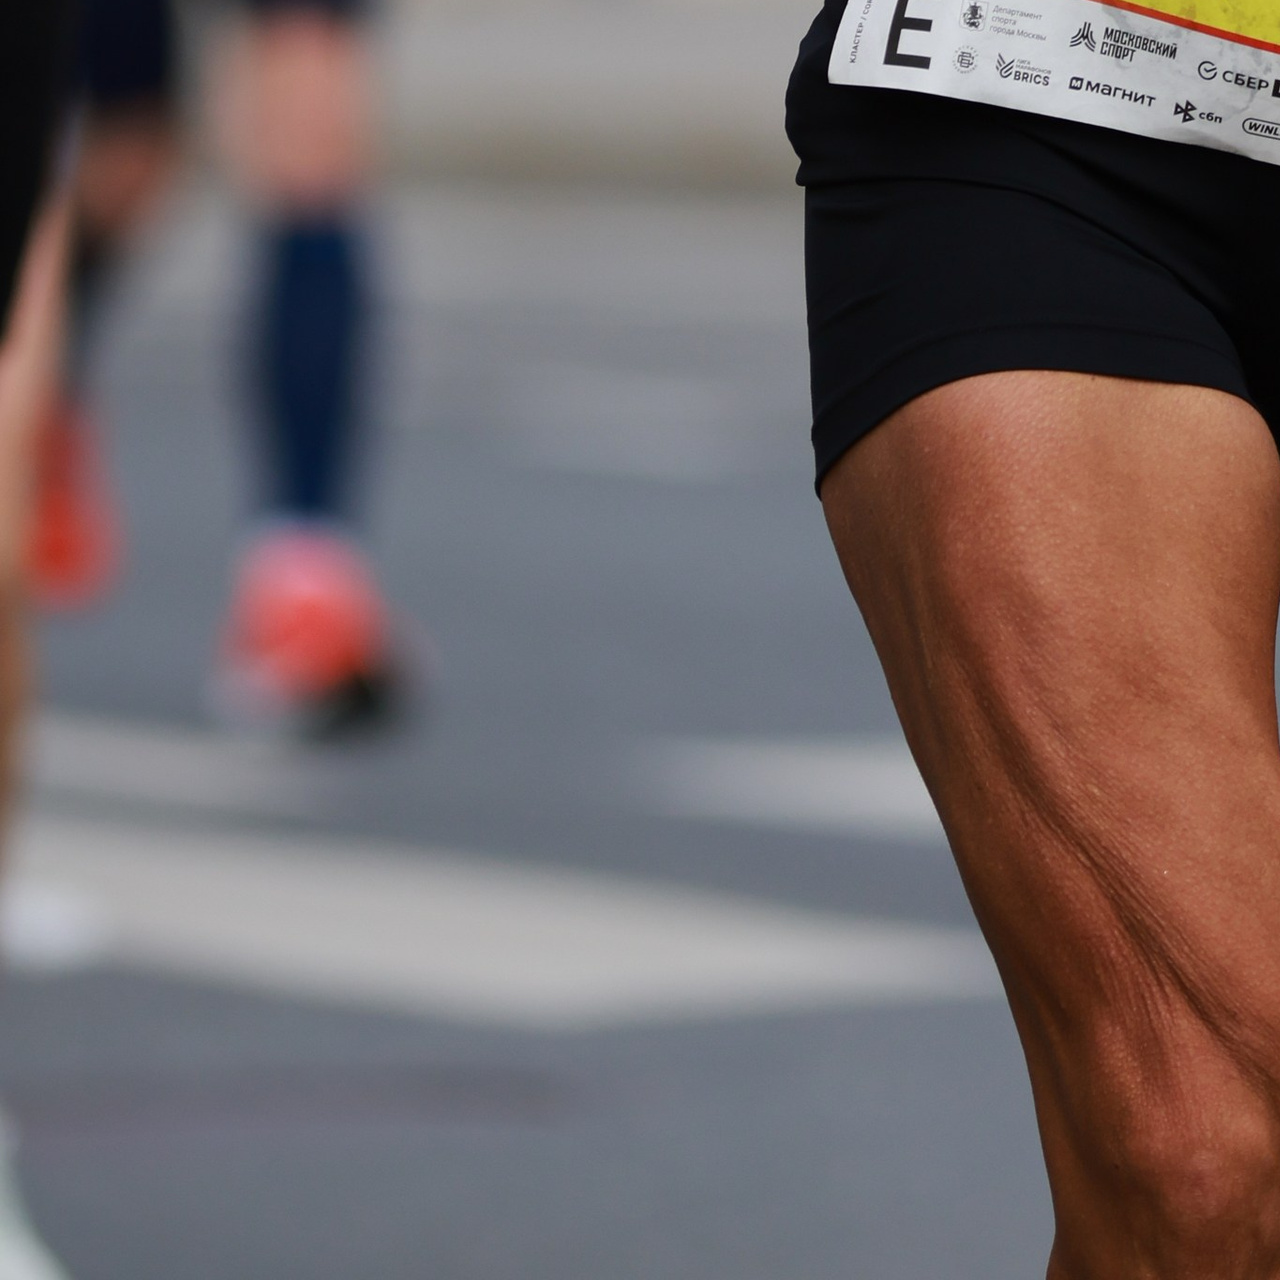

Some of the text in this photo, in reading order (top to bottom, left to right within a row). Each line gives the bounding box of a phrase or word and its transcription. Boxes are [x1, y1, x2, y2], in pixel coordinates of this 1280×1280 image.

[849, 22, 864, 64] КЛАСТЕР
[1100, 41, 1136, 62] СПОРТ
[1103, 26, 1178, 60] МОСКОВСКИЙ
[1013, 70, 1050, 87] BRICS
[1222, 70, 1269, 91] СБЕР
[1085, 80, 1156, 107] магнит
[1198, 111, 1223, 124] сбп
